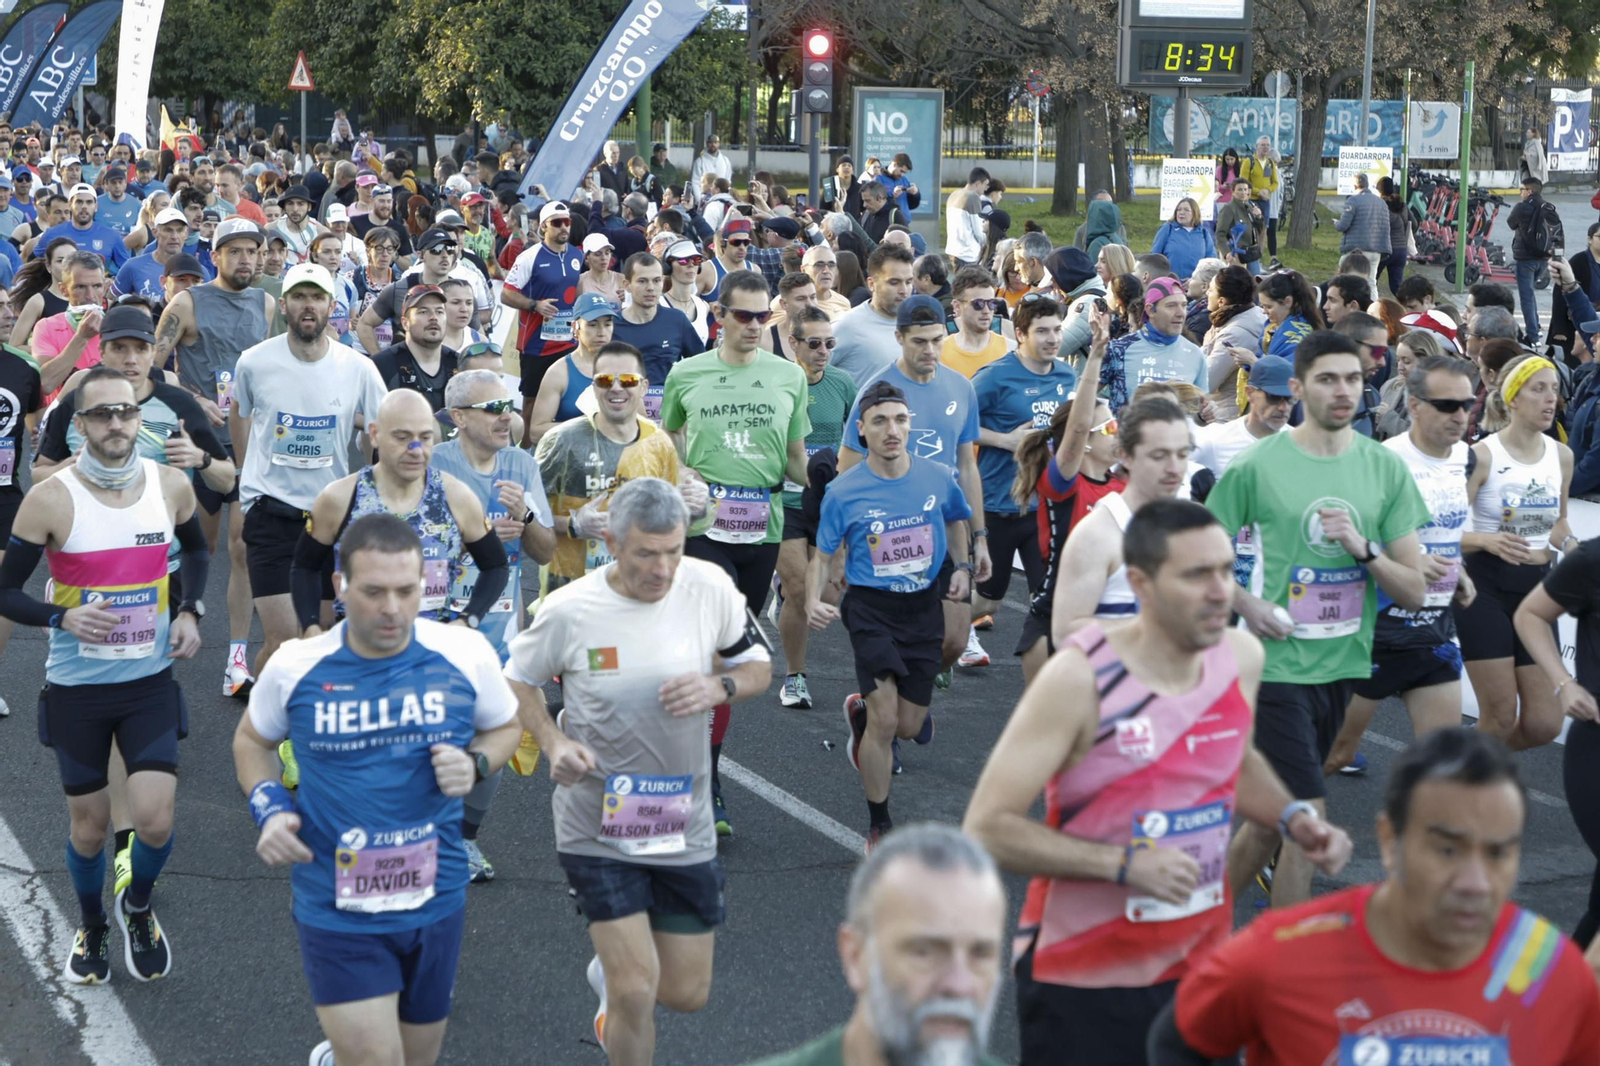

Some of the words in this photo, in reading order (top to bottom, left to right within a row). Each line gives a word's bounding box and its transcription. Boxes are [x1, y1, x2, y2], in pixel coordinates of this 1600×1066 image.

[1164, 43, 1236, 71] 8:34
[0, 44, 23, 93] BC
[560, 0, 663, 142] Cruzcampo
[30, 45, 75, 112] ABC
[51, 56, 87, 118] abcdesevilla.es
[866, 111, 908, 135] NO
[1553, 105, 1573, 148] P
[1434, 145, 1449, 153] min
[1340, 152, 1392, 161] GUARDARROPA
[1163, 165, 1214, 177] GUARDARROPA
[1339, 161, 1372, 170] BAGGAGE
[1163, 178, 1194, 188] BAGGAGE
[1162, 189, 1190, 199] SERVICE
[700, 402, 777, 419] MARATHON
[296, 419, 329, 428] ZURICH
[728, 420, 739, 429] ET
[295, 434, 315, 443] 6840
[287, 444, 321, 456] CHRIS
[730, 490, 764, 500] ZURICH
[1523, 496, 1556, 506] ZURICH
[729, 506, 748, 516] 9375
[713, 518, 767, 531] HRISTOPHE
[887, 515, 924, 530] ZURICH
[890, 535, 911, 546] 9049
[882, 545, 925, 562] A.SOLA
[1319, 570, 1361, 583] ZURICH
[108, 592, 150, 606] ZURICH
[1318, 605, 1341, 620] JAI
[131, 629, 156, 642] 1979
[314, 690, 446, 735] HELLAS
[638, 780, 685, 793] ZURICH
[637, 806, 663, 817] 8564
[1174, 806, 1223, 832] ZURICH
[373, 825, 427, 847] ZURICH
[600, 823, 650, 838] NELSON
[653, 821, 685, 836] SILVA
[375, 856, 406, 871] 9229
[355, 869, 422, 895] DAVIDE
[1397, 1043, 1491, 1066] ZURICH
